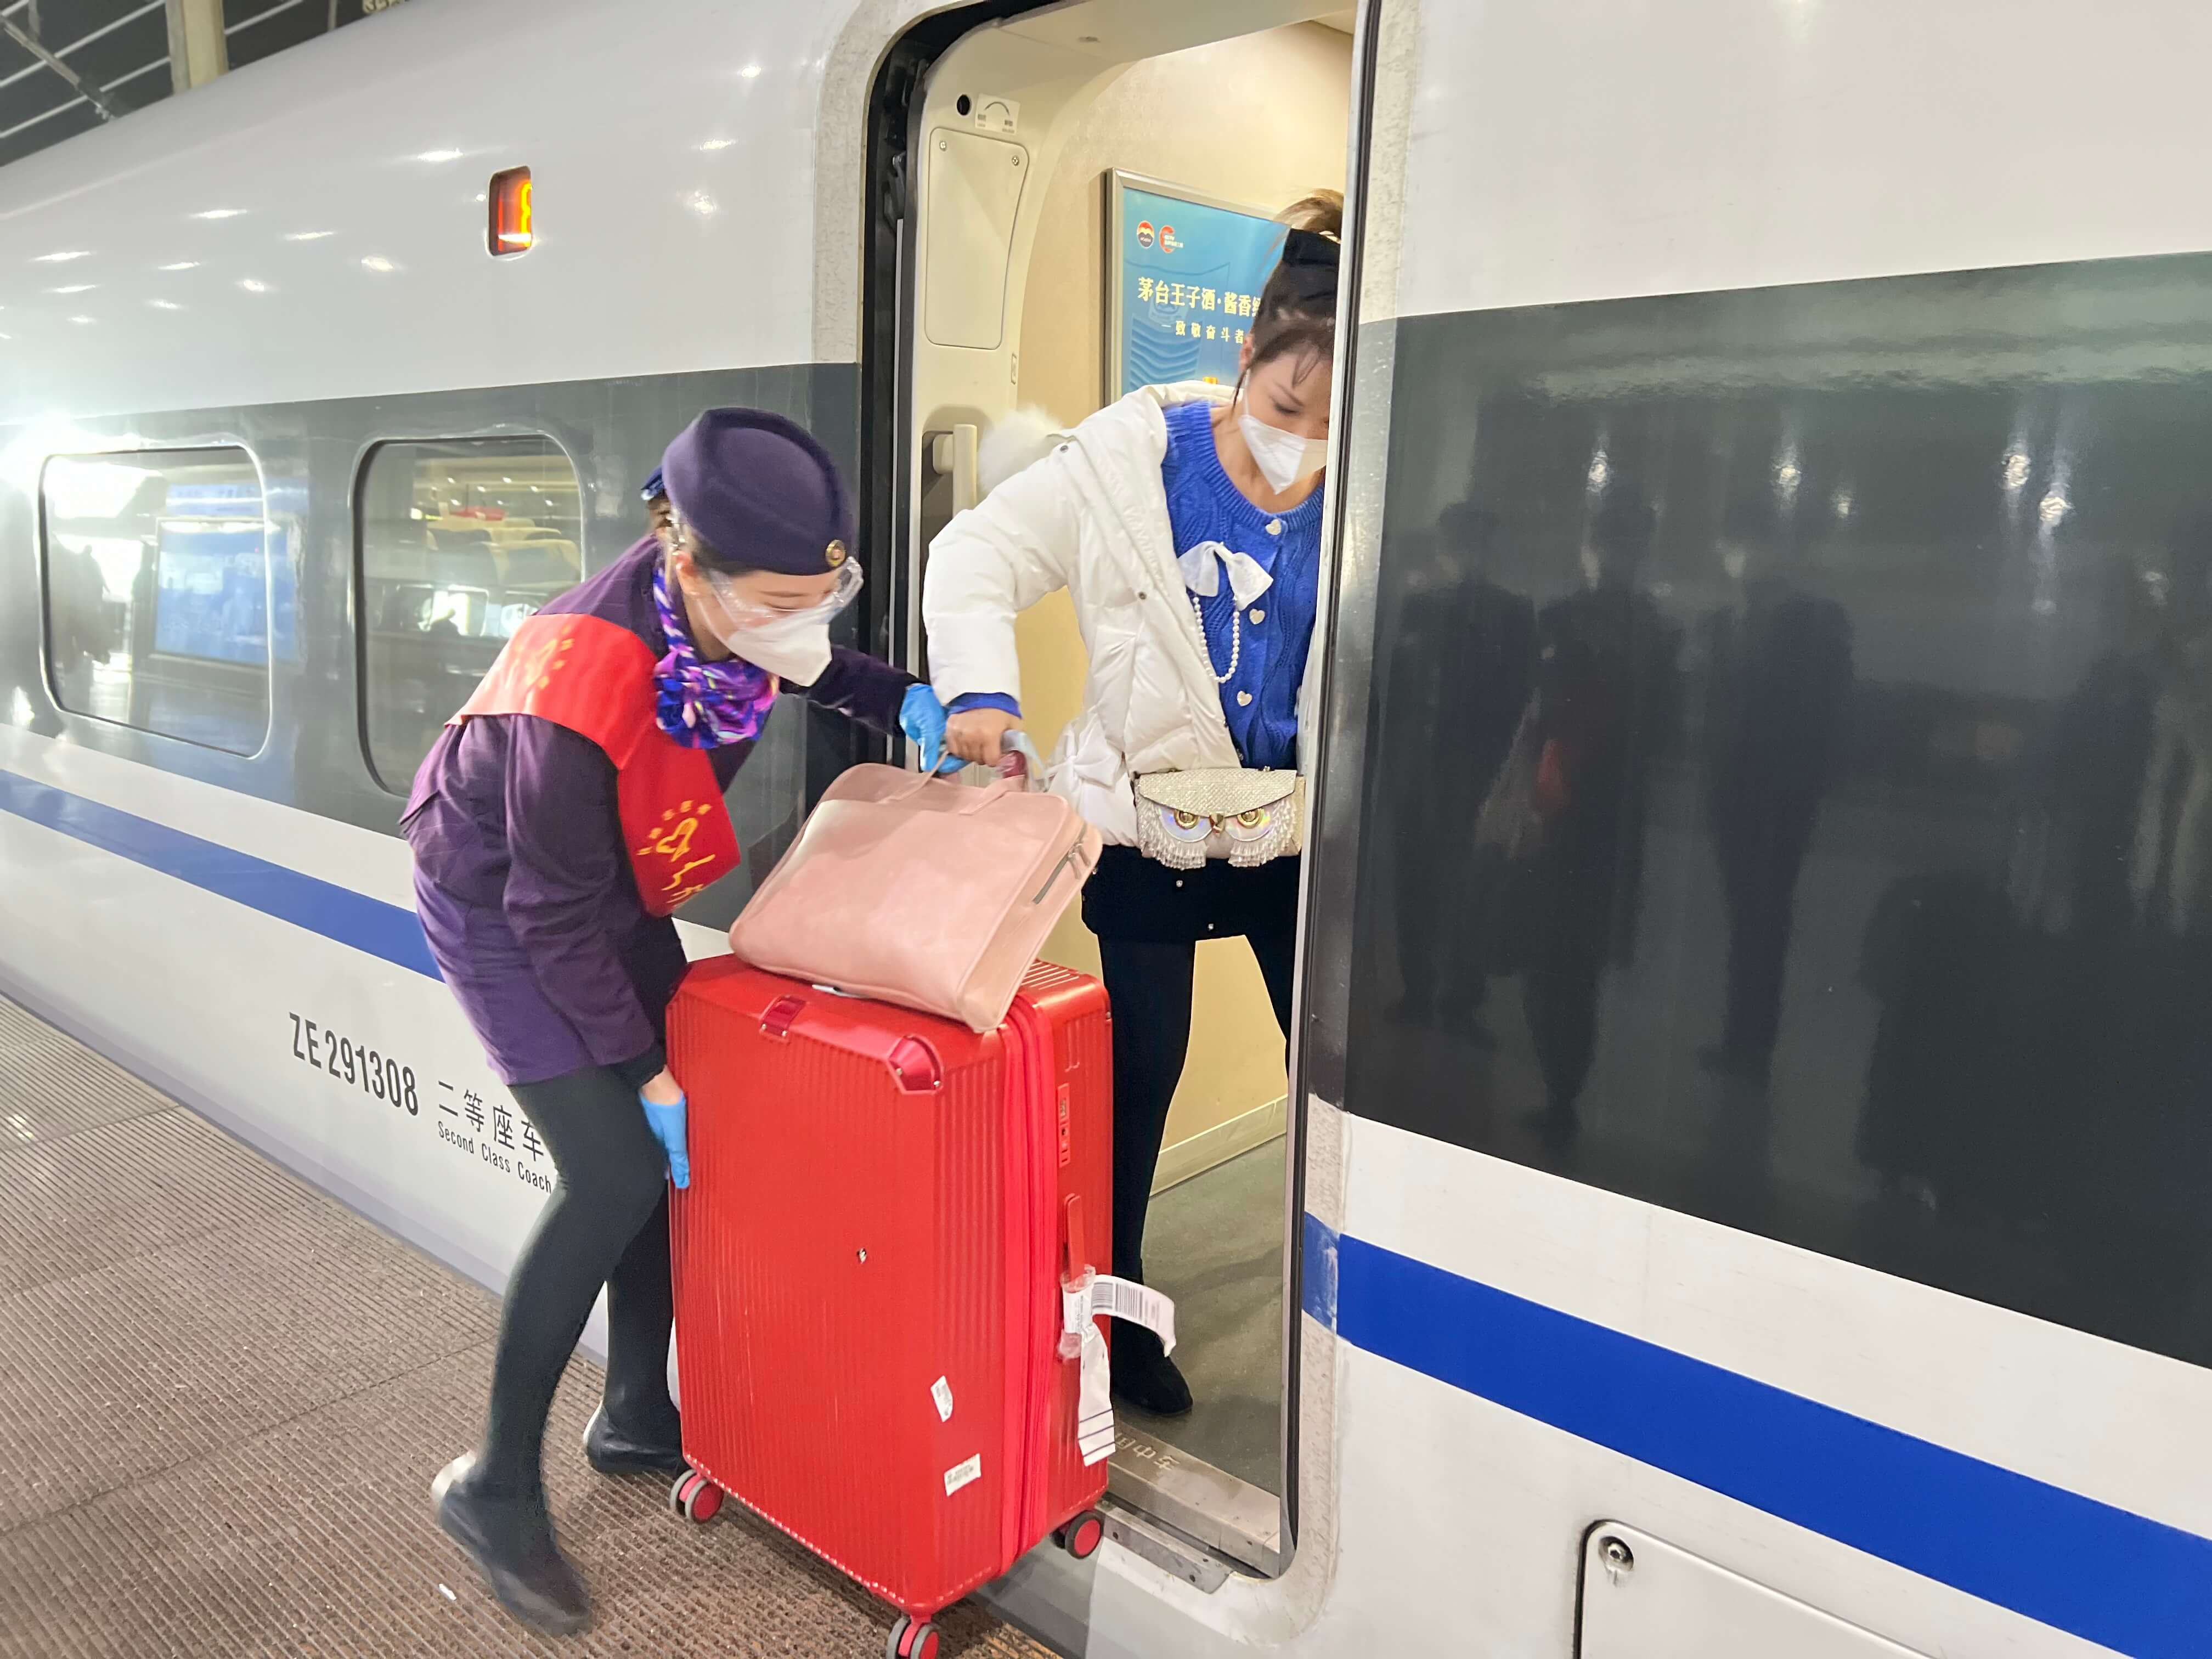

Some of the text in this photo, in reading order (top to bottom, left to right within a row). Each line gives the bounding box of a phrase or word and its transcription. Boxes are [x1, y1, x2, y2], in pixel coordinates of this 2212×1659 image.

[438, 1080, 544, 1162] 二等座车
[438, 1120, 551, 1194] Second Class Coach
